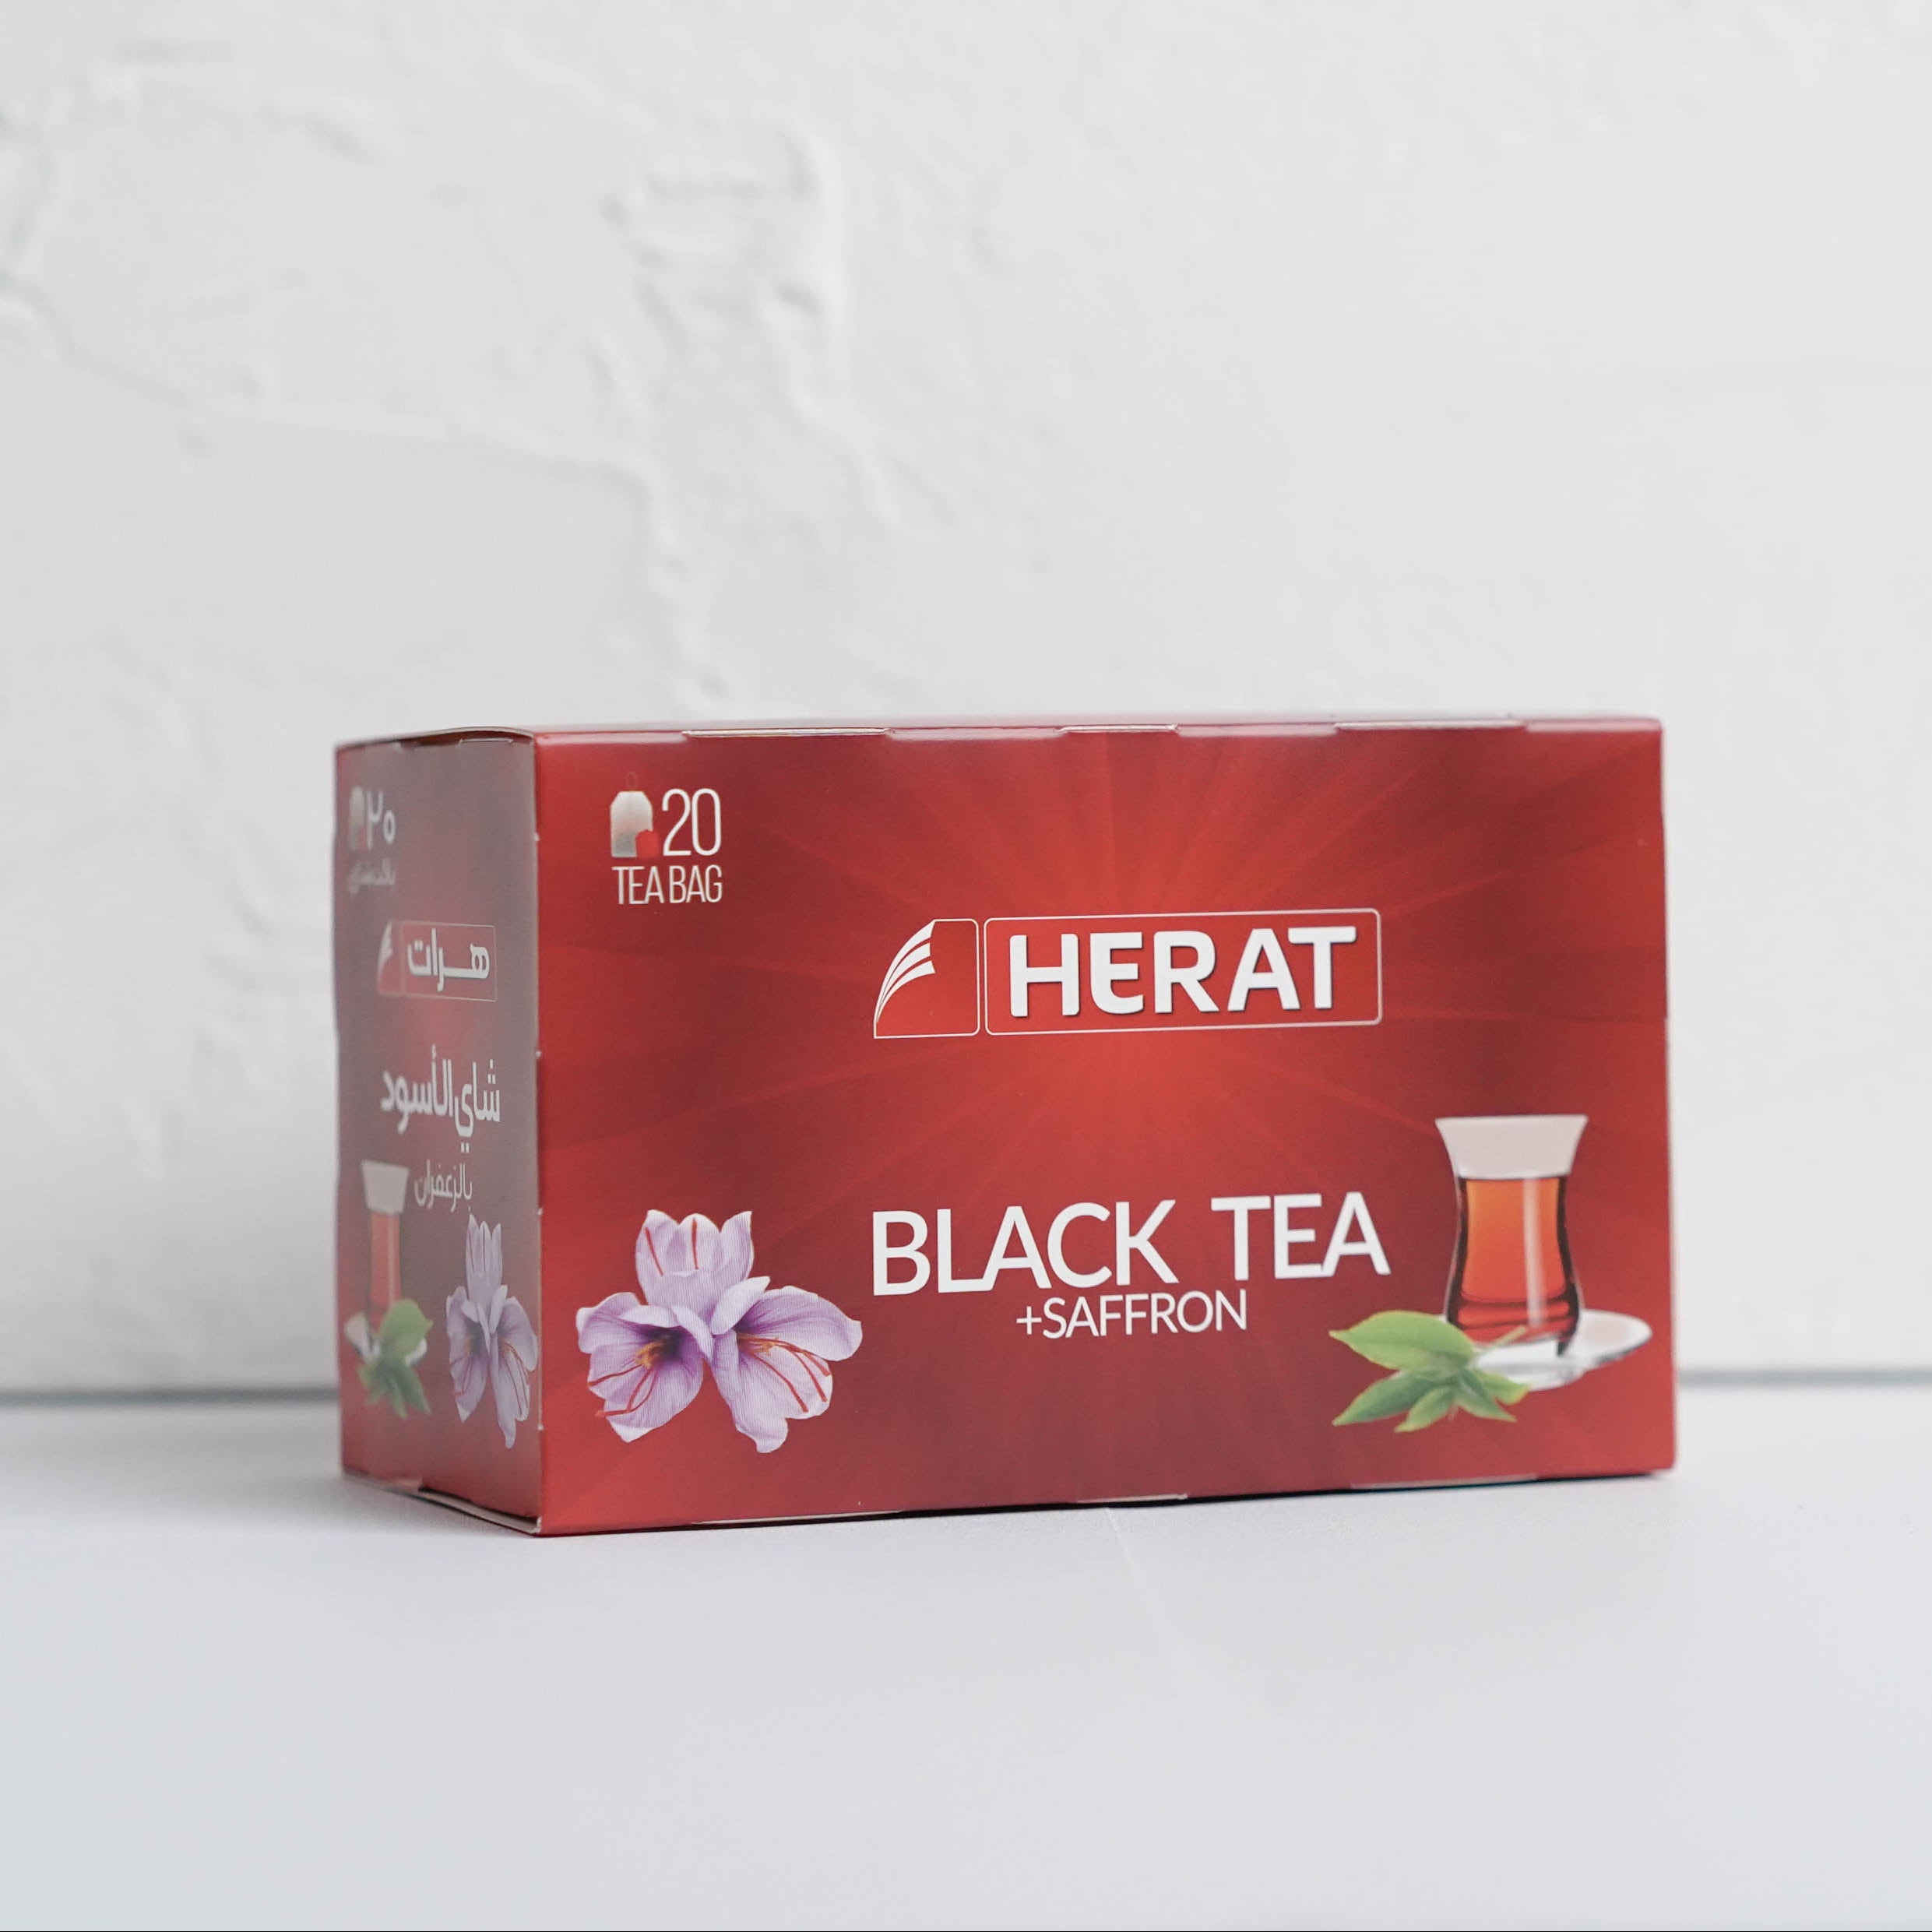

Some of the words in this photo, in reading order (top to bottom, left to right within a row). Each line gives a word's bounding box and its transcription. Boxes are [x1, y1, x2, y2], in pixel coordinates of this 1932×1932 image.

[662, 788, 721, 856] 20
[611, 865, 664, 904] TEA
[668, 864, 723, 903] BAG
[1009, 926, 1357, 1017] HERAT
[454, 1058, 501, 1153] شاي
[872, 1199, 1179, 1296] BLACK
[1210, 1191, 1391, 1282] TEA
[1016, 1289, 1247, 1339] +SAFFRON
